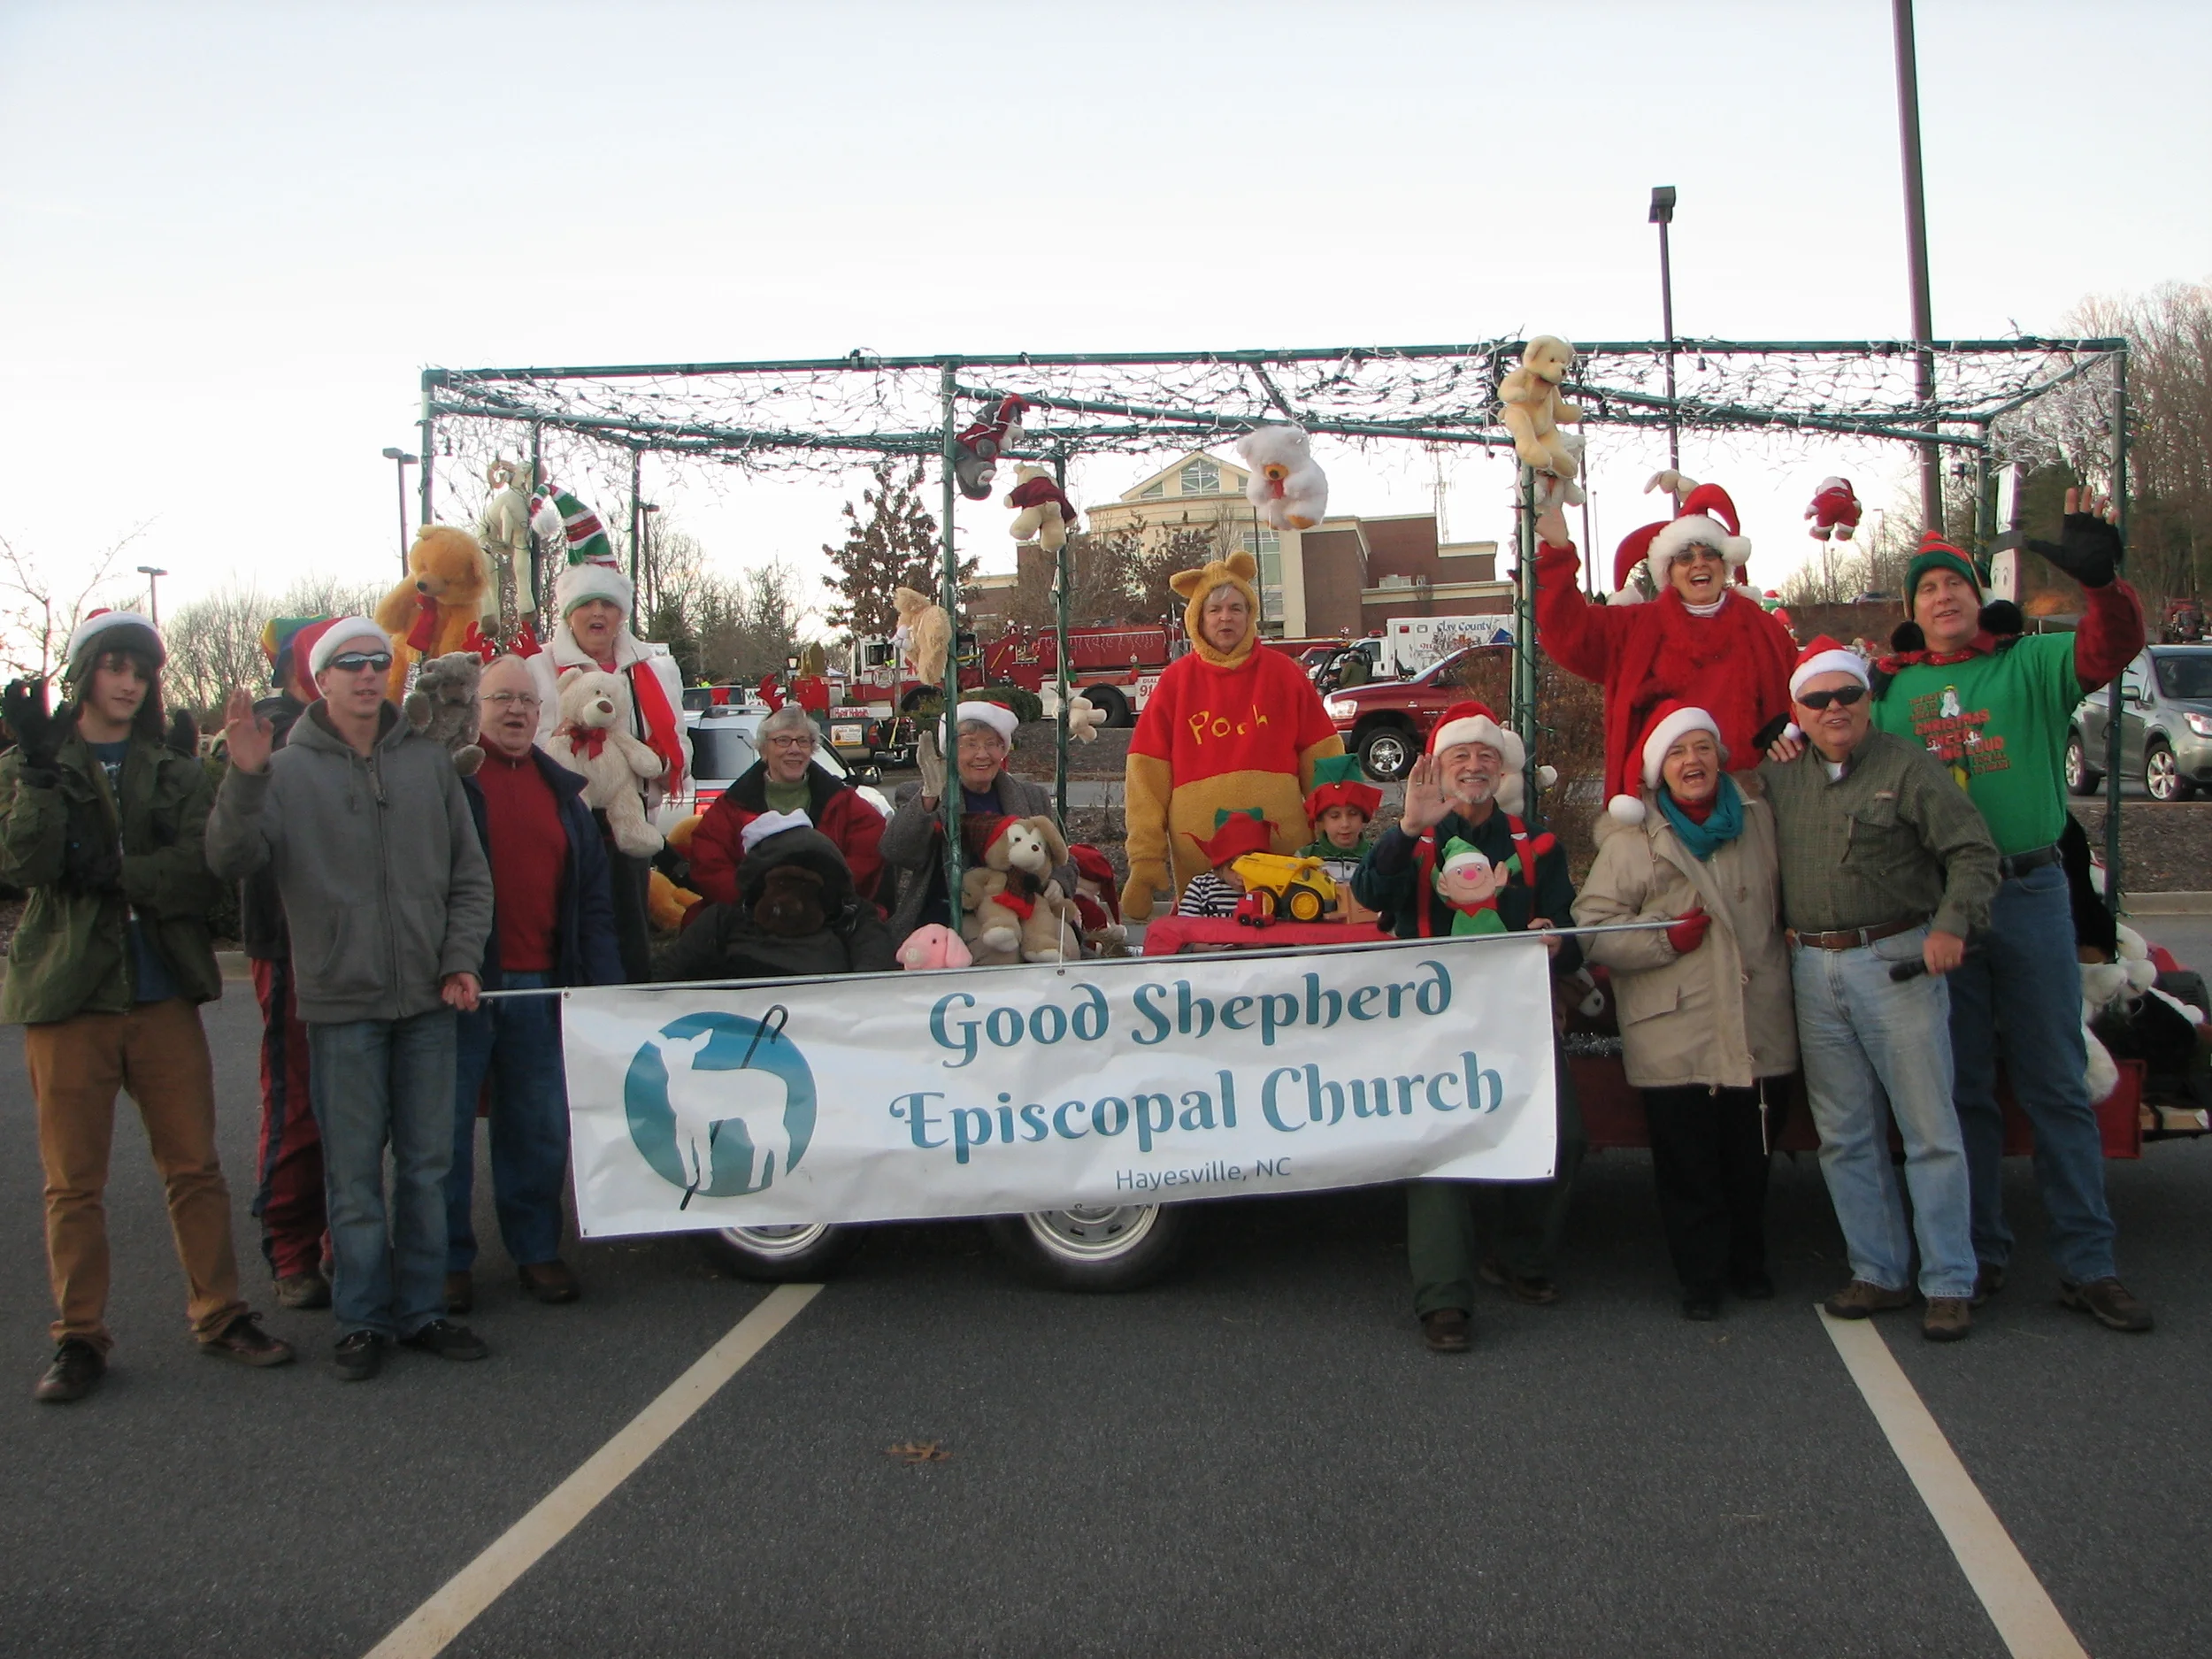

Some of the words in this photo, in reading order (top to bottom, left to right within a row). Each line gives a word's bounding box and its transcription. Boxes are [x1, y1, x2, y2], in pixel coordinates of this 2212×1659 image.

[1458, 621, 1492, 632] County
[1139, 684, 1154, 697] 91
[1915, 709, 1990, 736] CHRISTMAS
[929, 983, 1110, 1068] Good
[1132, 960, 1453, 1046] Shepherd
[889, 1070, 1237, 1164] Episcopal
[1261, 1051, 1503, 1133] Church
[1116, 1158, 1248, 1192] Hayesville,
[1256, 1156, 1292, 1179] NC
